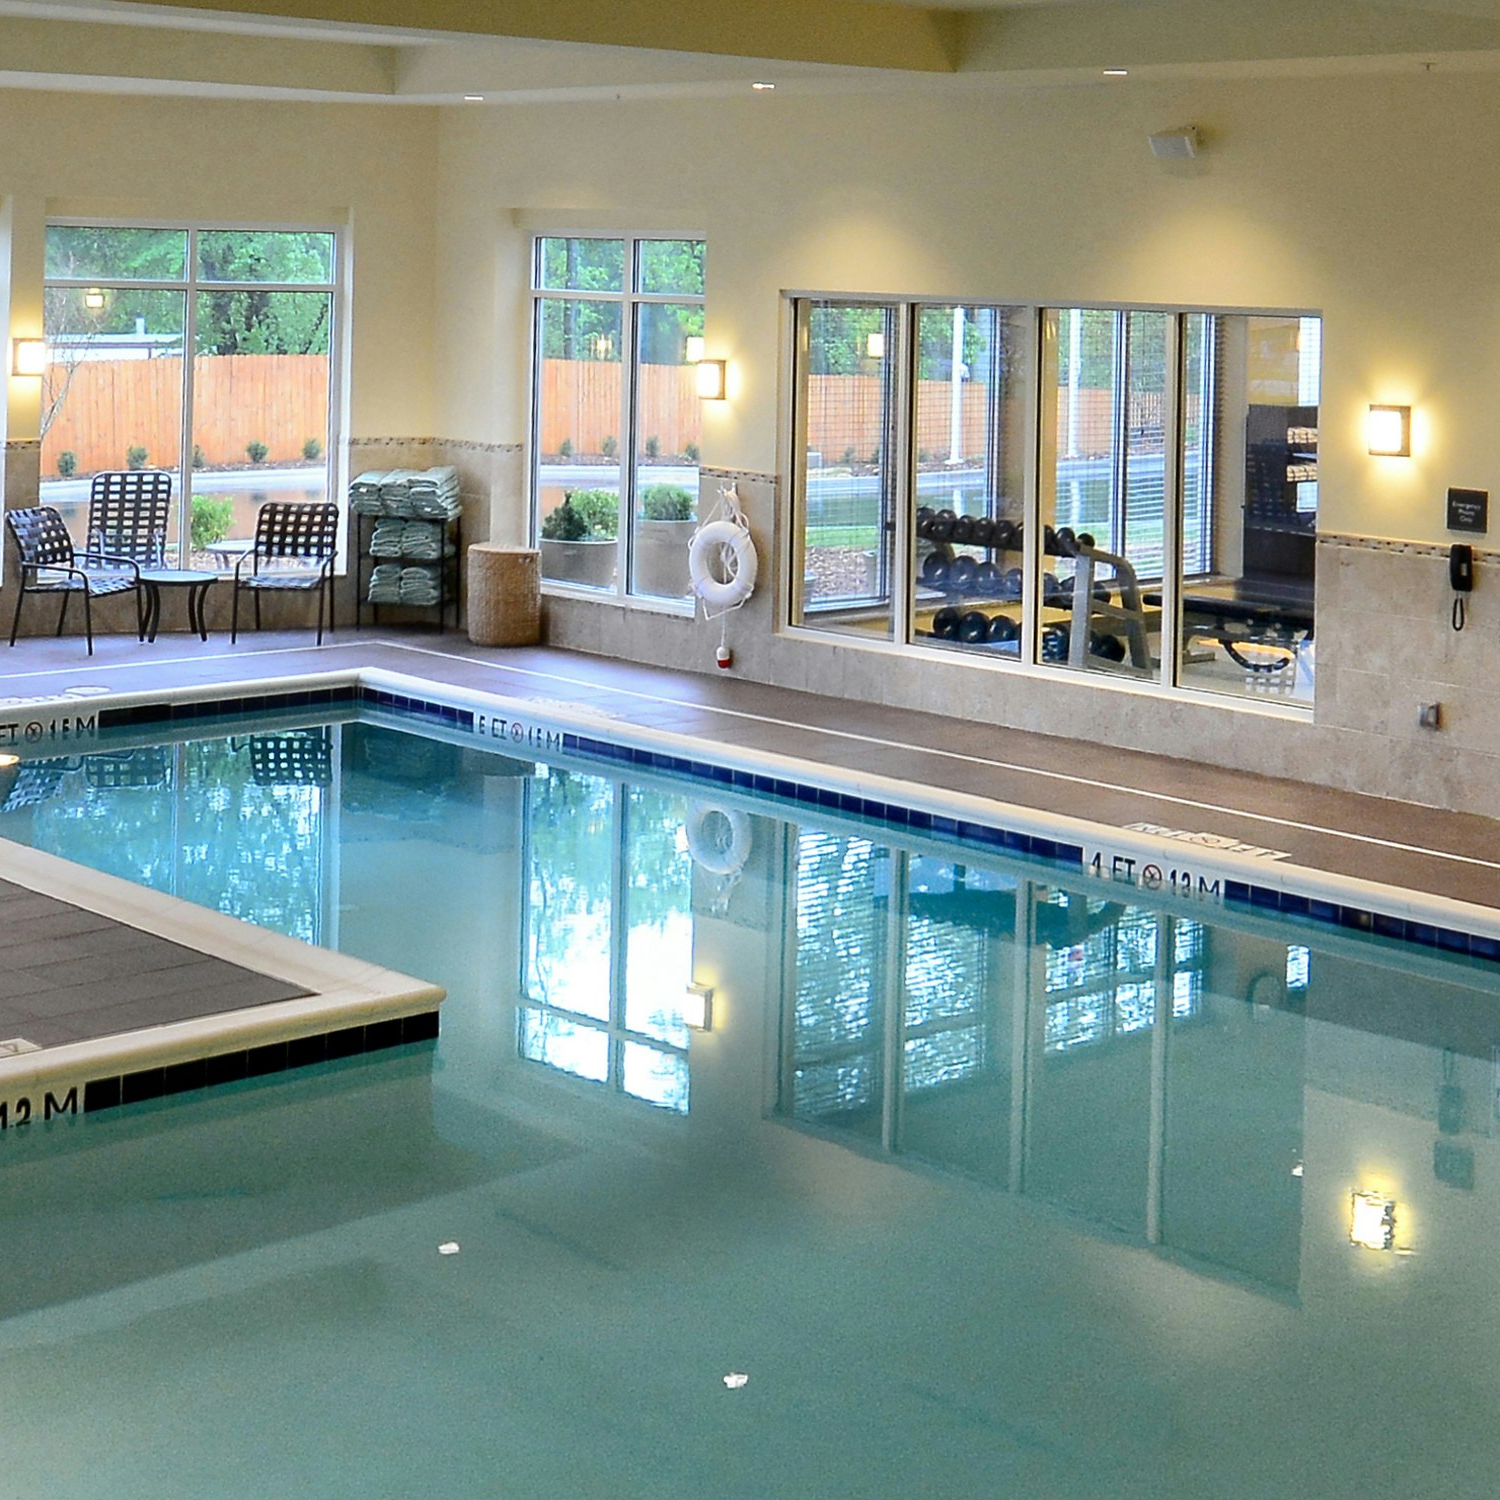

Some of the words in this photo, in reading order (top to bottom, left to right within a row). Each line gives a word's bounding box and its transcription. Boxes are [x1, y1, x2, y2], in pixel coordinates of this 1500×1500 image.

[76, 716, 95, 732] M
[1113, 856, 1136, 878] FT
[1199, 876, 1220, 897] M
[44, 1087, 77, 1120] M
